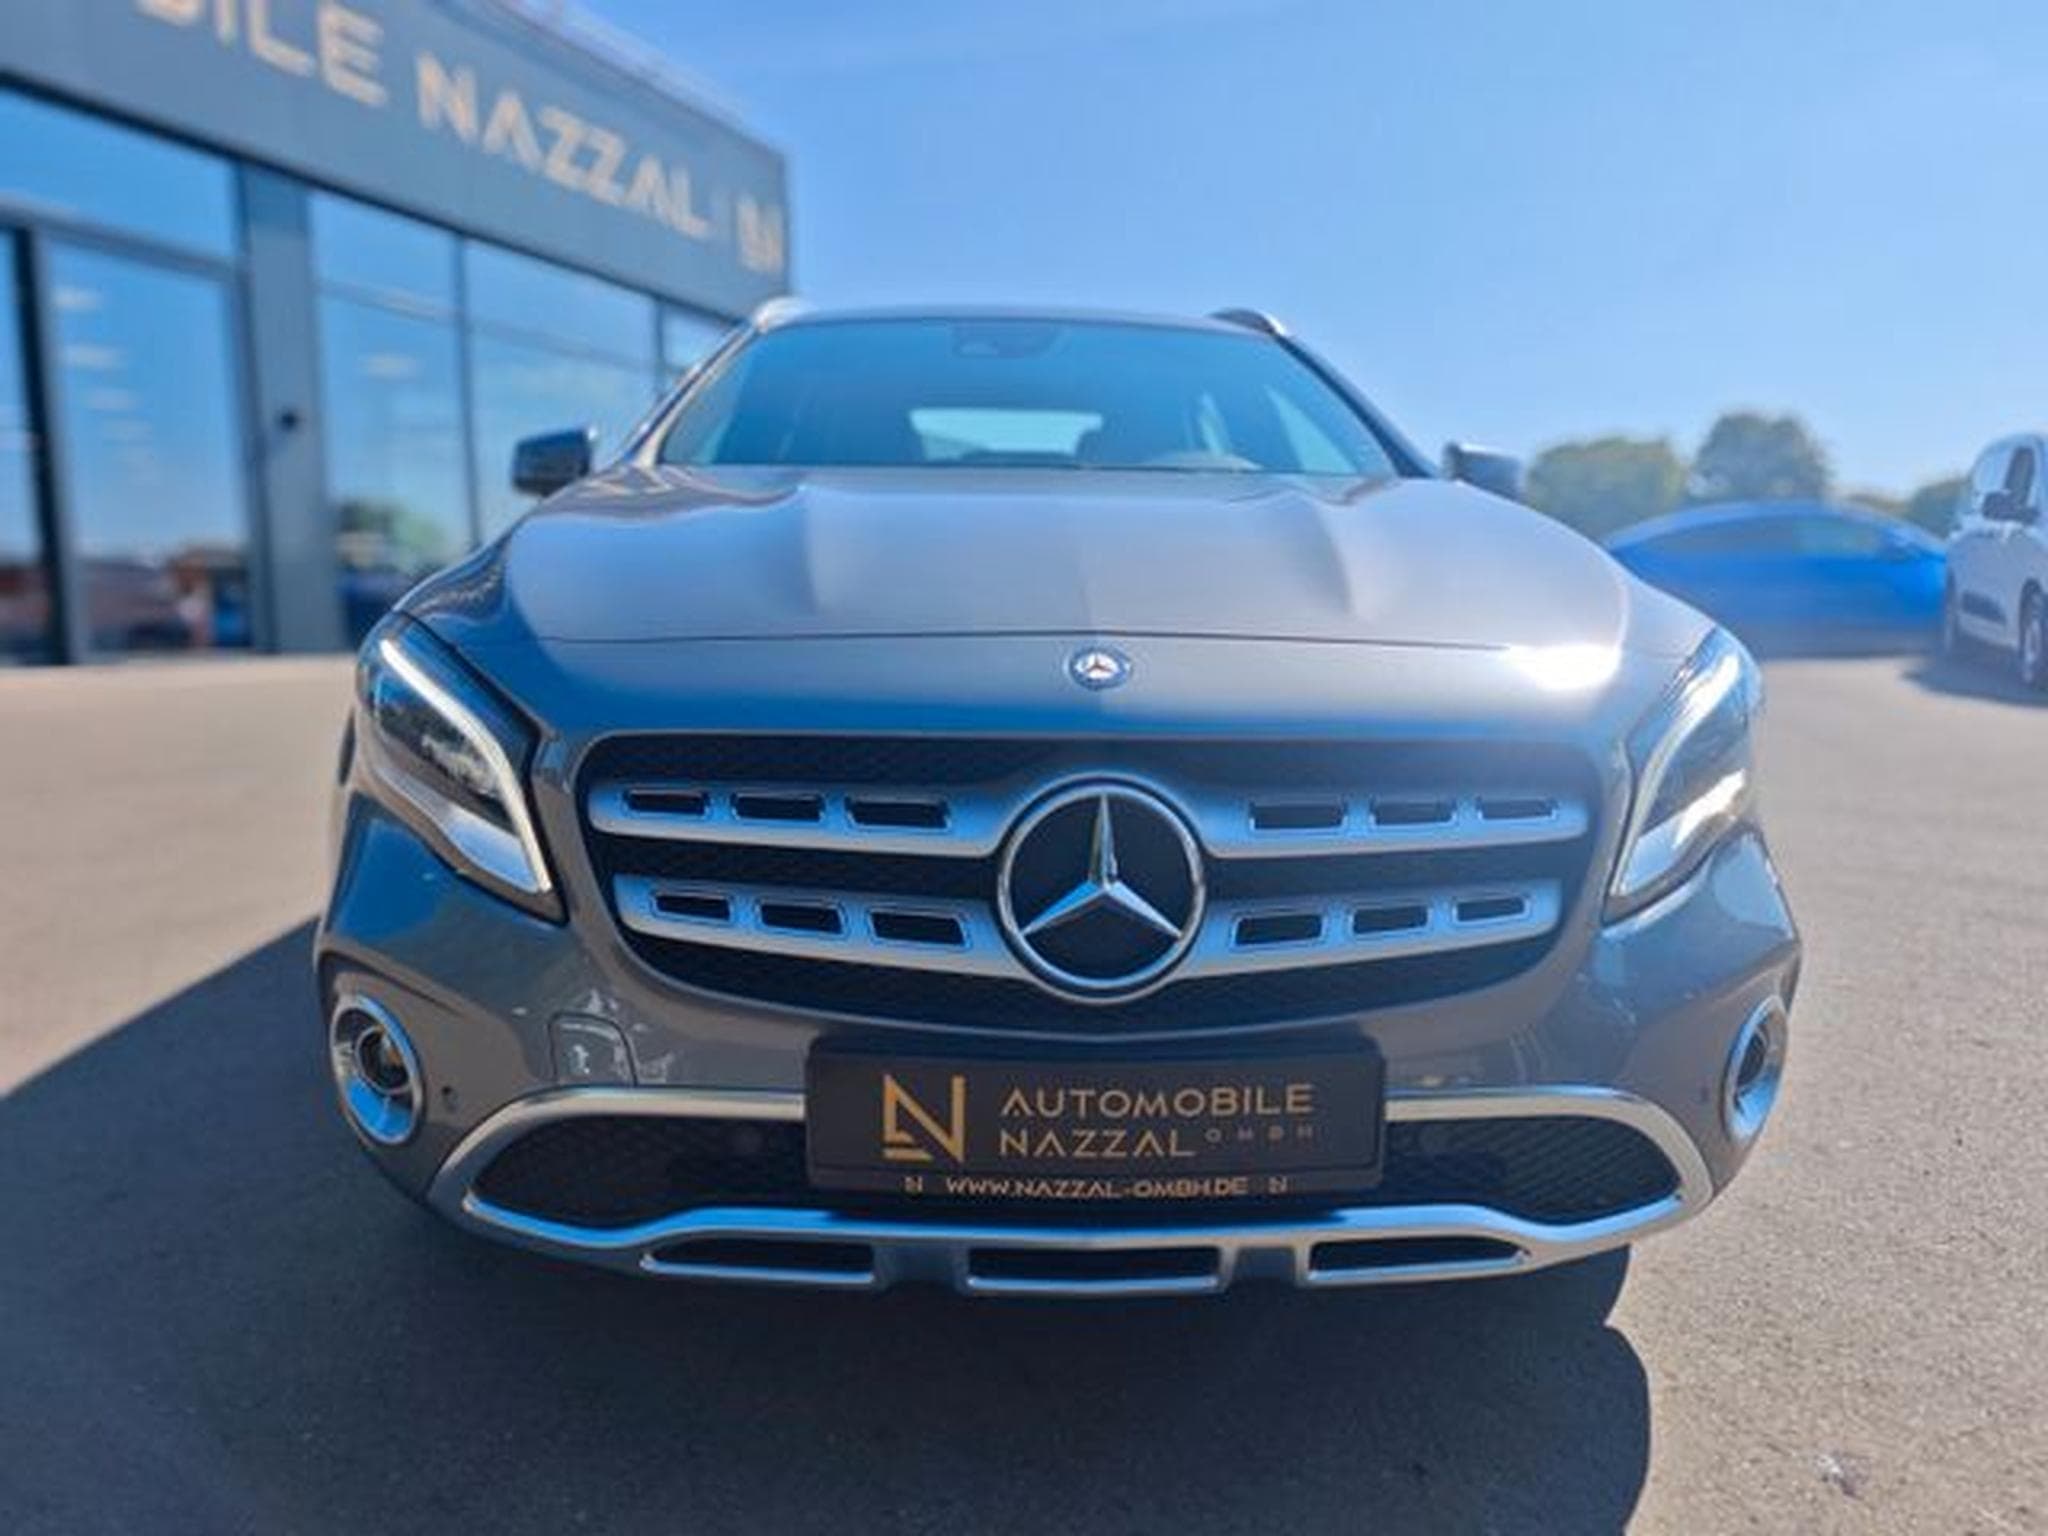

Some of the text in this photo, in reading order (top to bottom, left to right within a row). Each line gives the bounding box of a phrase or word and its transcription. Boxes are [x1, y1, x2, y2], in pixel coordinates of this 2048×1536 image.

[415, 51, 709, 239] NAZZAL
[1001, 1082, 1314, 1119] AUTOMOBILE
[1000, 1127, 1197, 1159] NAZZAL
